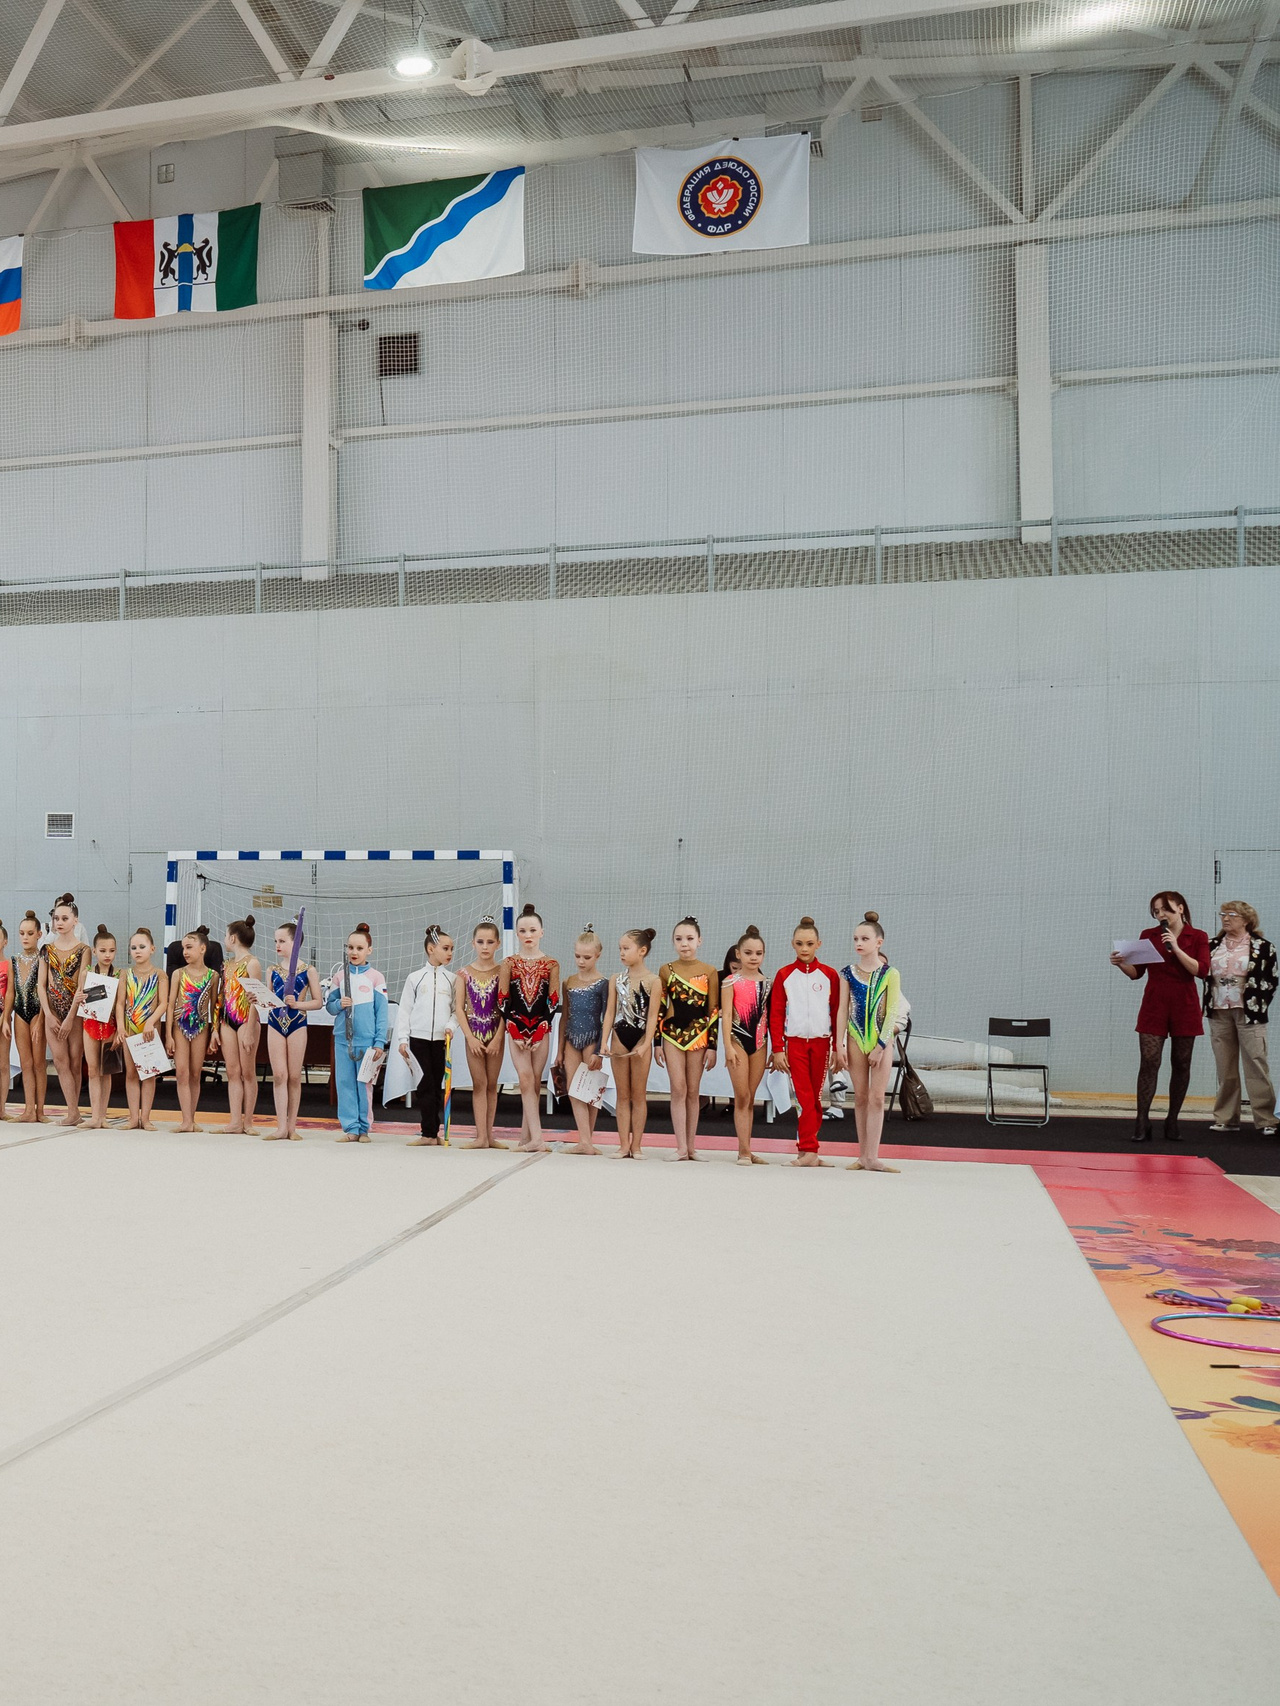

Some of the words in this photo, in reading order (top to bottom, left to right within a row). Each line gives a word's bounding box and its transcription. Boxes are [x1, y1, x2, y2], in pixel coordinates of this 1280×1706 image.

[682, 166, 711, 221] ФЕДЕРАЦИЯ
[713, 161, 751, 179] ДЗЮДО
[742, 179, 757, 217] РОССИИ
[707, 222, 732, 234] ФДР
